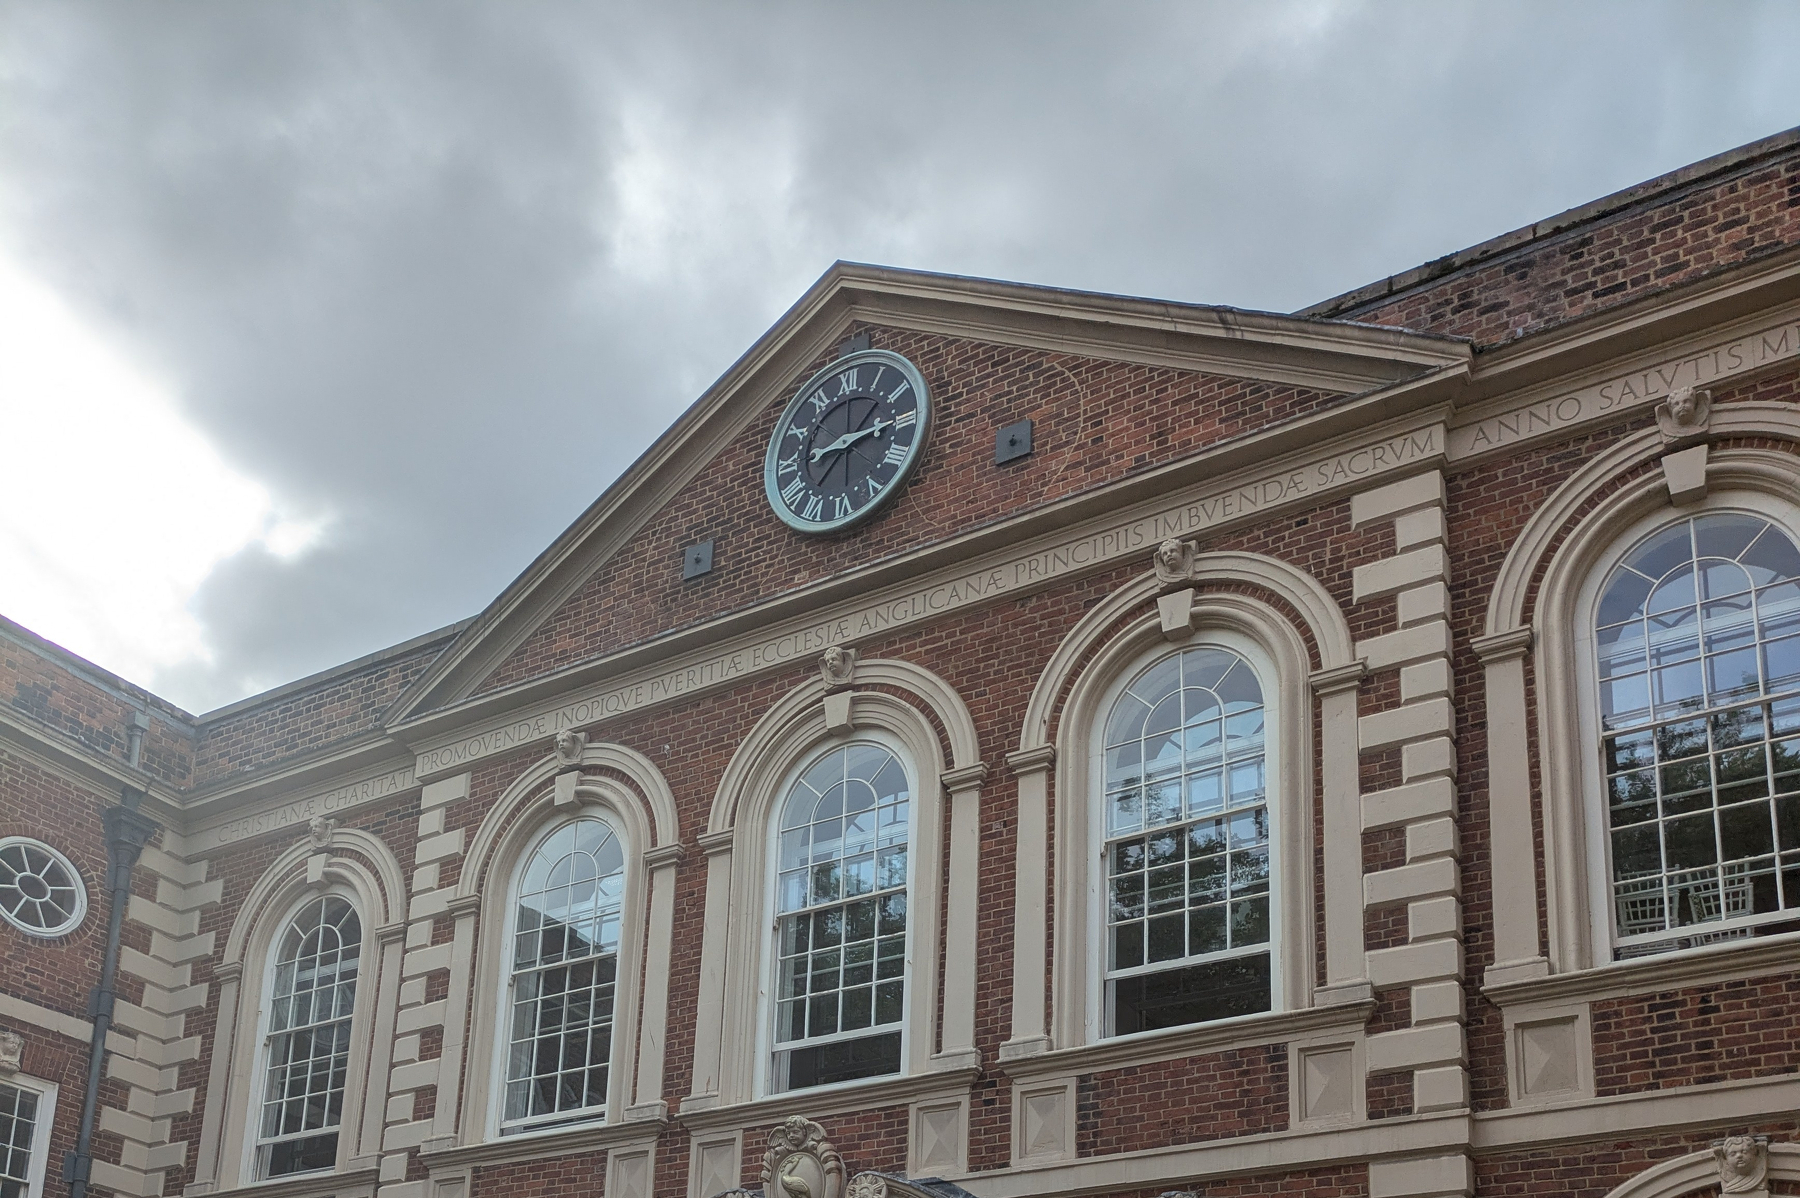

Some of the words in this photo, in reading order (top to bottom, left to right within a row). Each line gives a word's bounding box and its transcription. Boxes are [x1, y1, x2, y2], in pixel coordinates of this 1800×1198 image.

[838, 367, 859, 396] XII
[870, 366, 886, 390] I
[807, 387, 831, 414] XI
[888, 379, 910, 403] II
[895, 408, 917, 430] III
[786, 422, 808, 441] X
[867, 476, 884, 499] V
[834, 496, 854, 520] VI
[218, 800, 316, 842] CHRISTIANÆ
[324, 768, 415, 810] CHARITATI
[421, 717, 547, 772] PROMOVENDÆ
[554, 686, 643, 730] INOPIQVE
[650, 656, 744, 699] PVERITIÆ
[751, 619, 850, 667] ECCLESIÆ
[857, 569, 1006, 633] ANGLICANÆ
[1014, 523, 1144, 584] PRINCIPIIS
[1153, 472, 1308, 539] IMBVENDÆ
[1317, 429, 1436, 487] SACRVM
[1469, 397, 1582, 450] ANNO
[1599, 343, 1743, 411] SALVTIS
